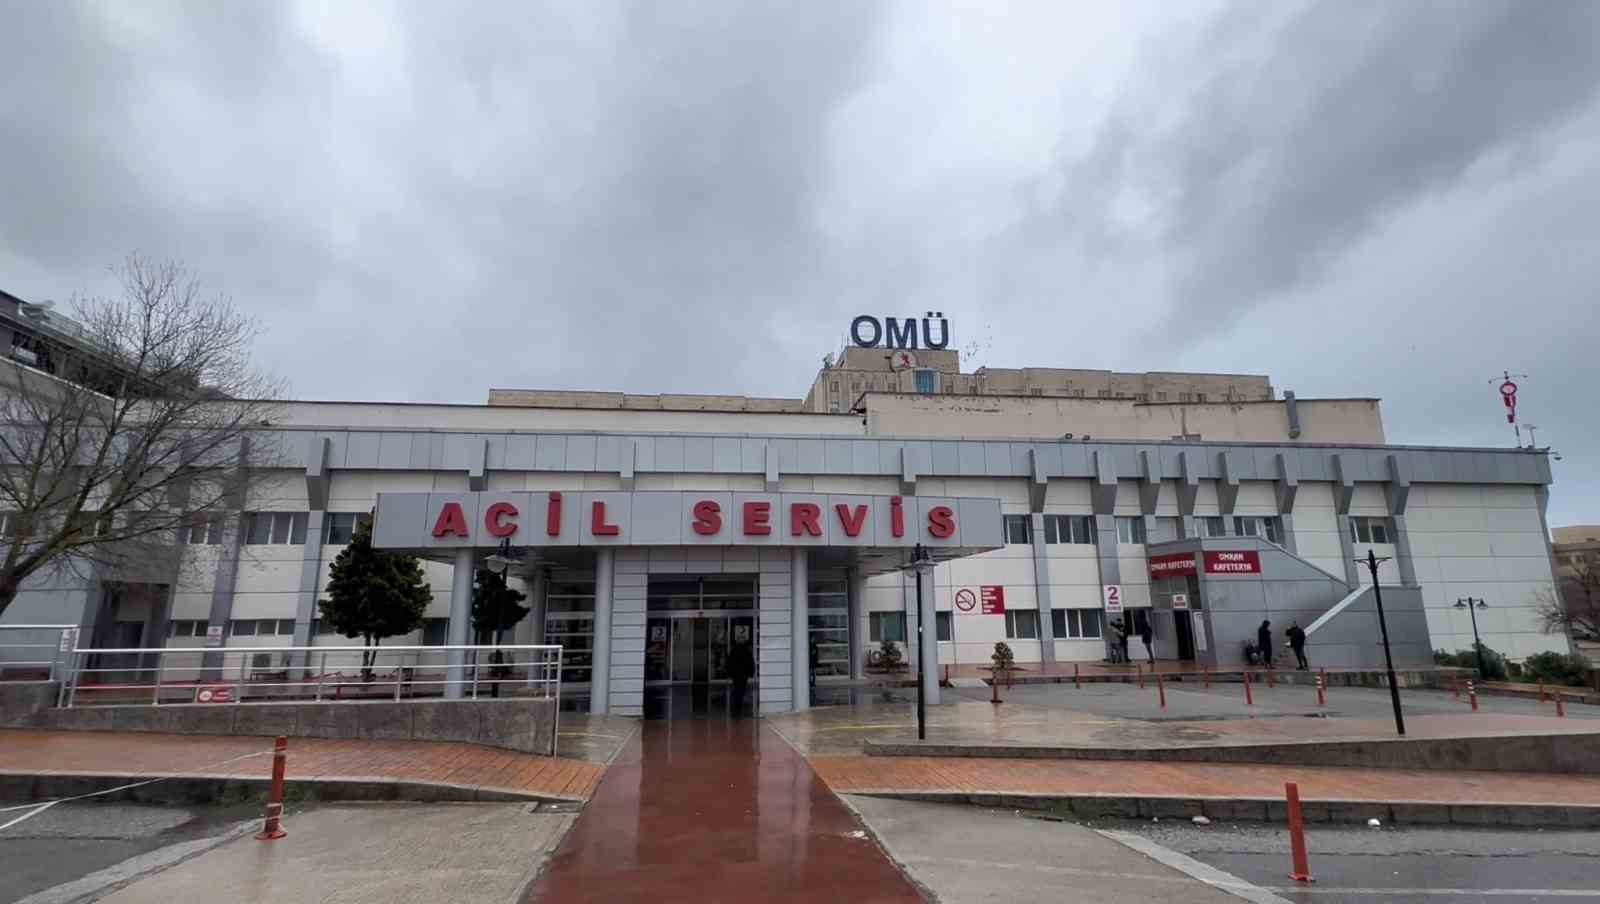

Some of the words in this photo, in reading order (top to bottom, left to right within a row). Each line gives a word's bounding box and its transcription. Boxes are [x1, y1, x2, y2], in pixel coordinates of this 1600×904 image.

[851, 312, 948, 350] OMÜ
[432, 491, 619, 537] ACİL
[692, 496, 955, 538] SERVİS
[1213, 562, 1253, 571] KAFETERYA
[1107, 586, 1119, 600] 2
